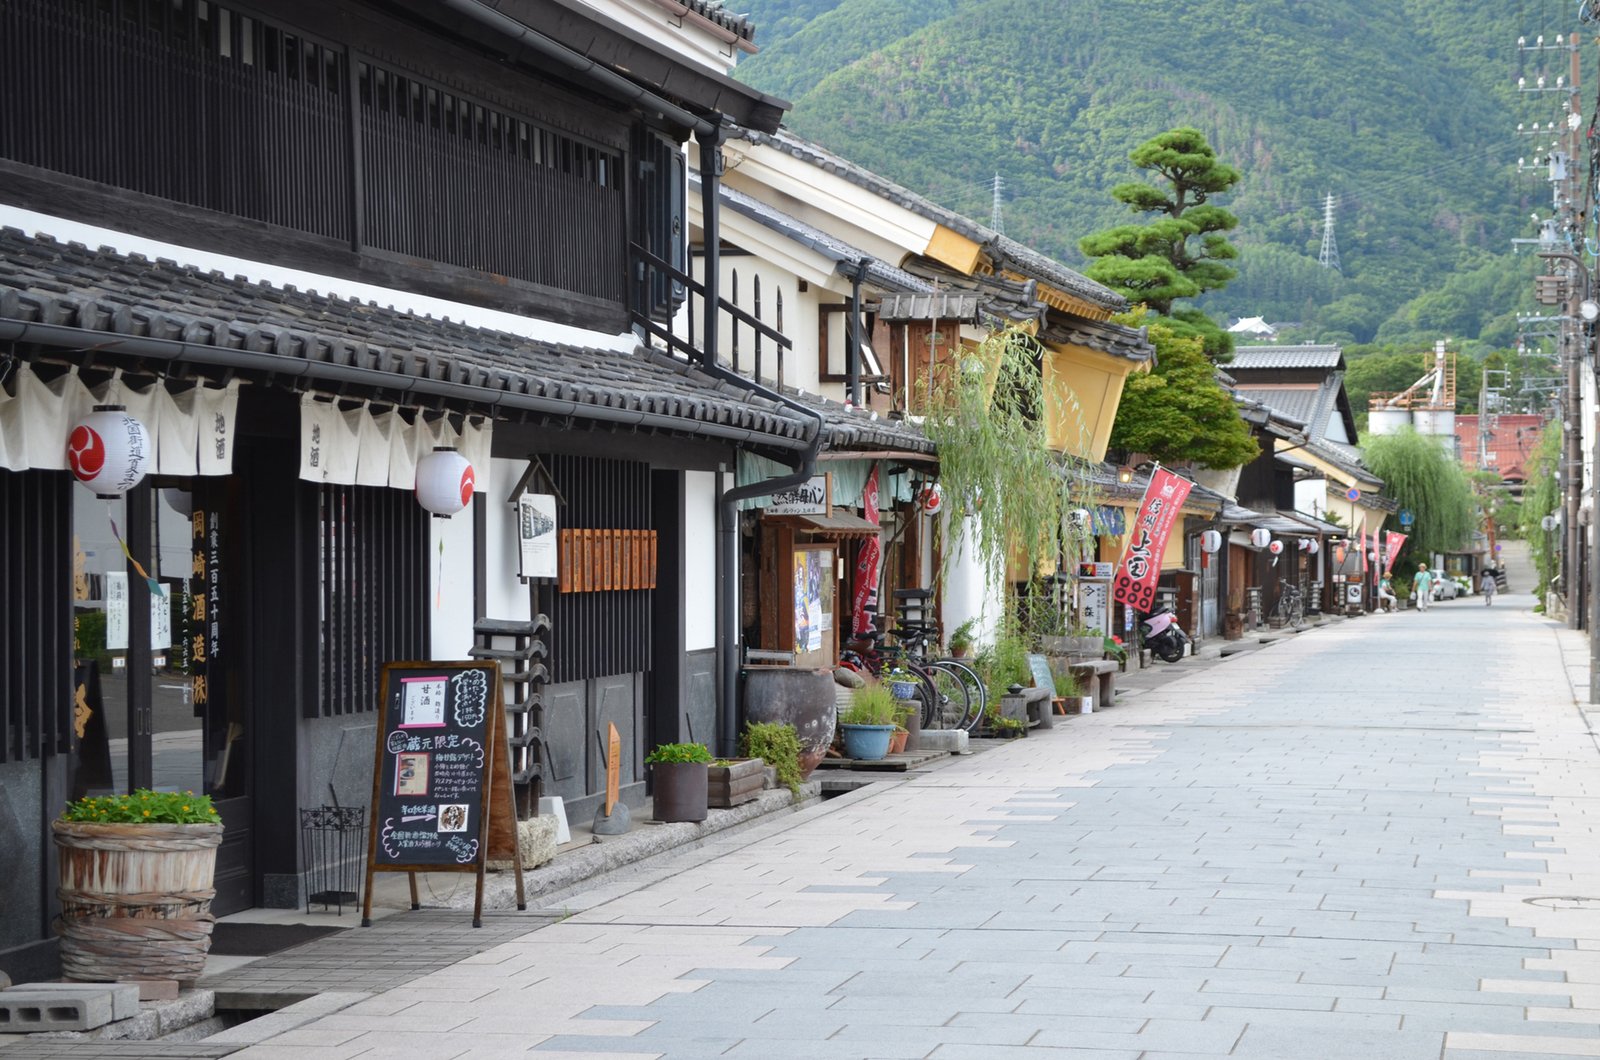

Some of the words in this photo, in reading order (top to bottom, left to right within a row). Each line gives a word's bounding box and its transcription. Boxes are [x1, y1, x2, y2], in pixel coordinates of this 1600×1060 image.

[1127, 497, 1163, 580] 信州上田
[421, 684, 431, 706] 甘酒
[406, 734, 460, 751] 蔵元限定
